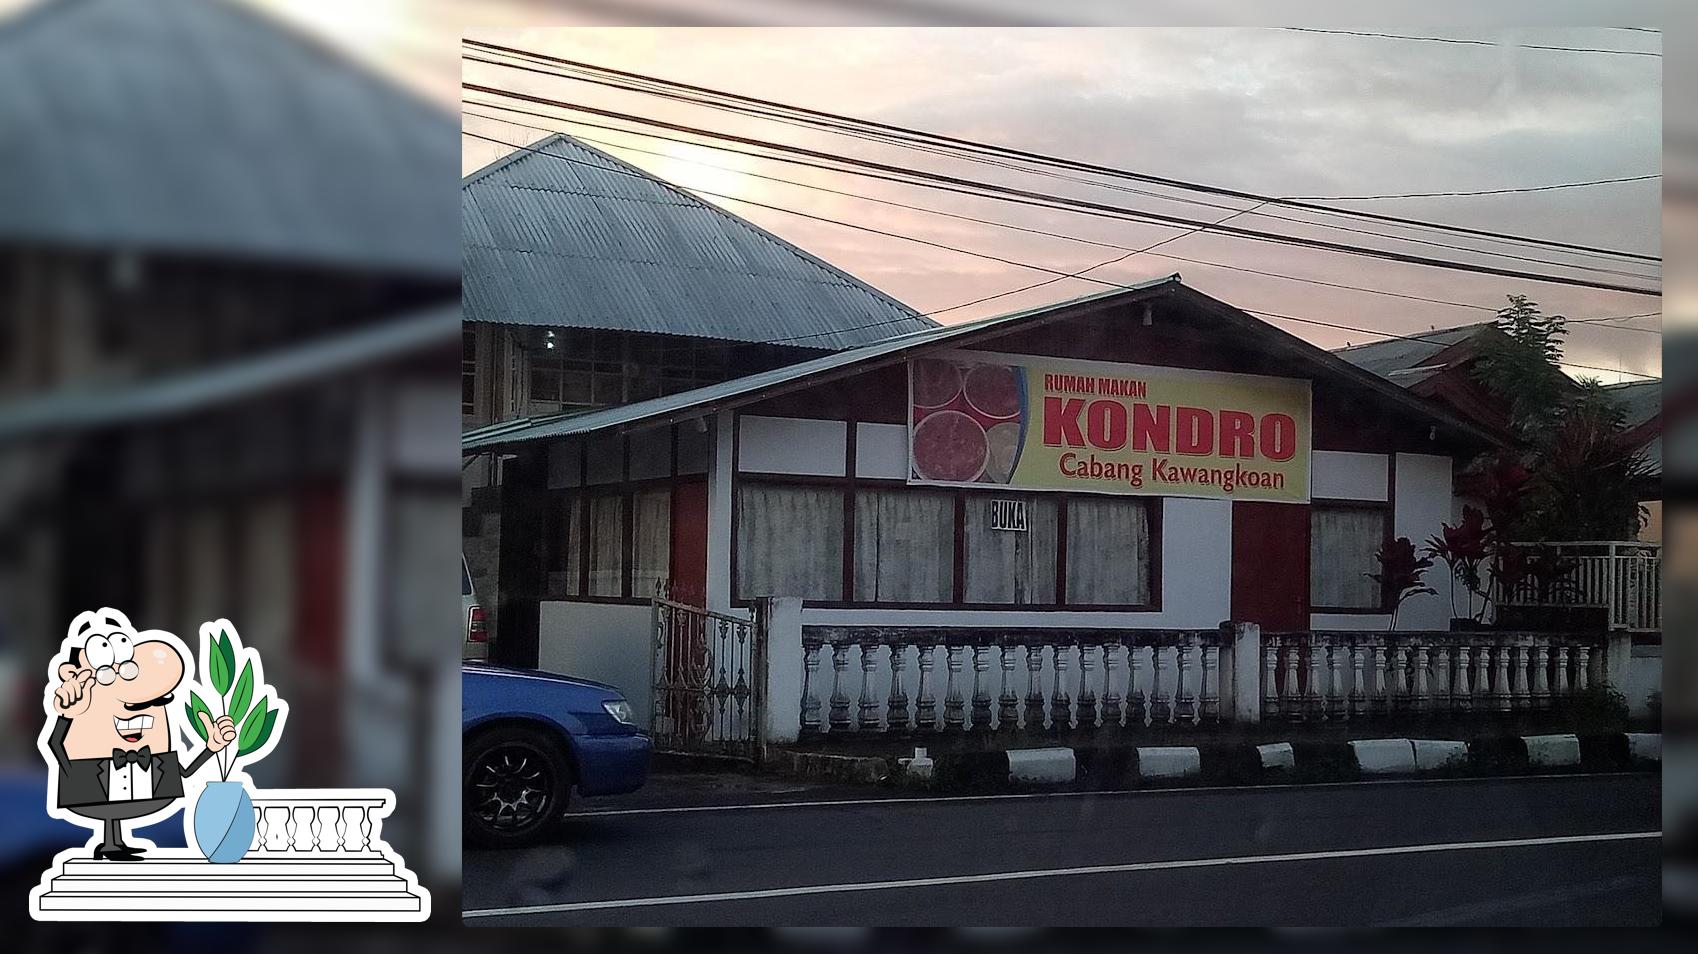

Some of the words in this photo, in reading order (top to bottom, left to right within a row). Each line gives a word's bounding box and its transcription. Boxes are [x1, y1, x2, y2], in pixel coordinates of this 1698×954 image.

[1044, 373, 1095, 394] RUMAH
[1098, 378, 1147, 399] MAKAN
[1043, 397, 1296, 462] KONDRO
[1059, 453, 1143, 488] Cabang
[1152, 458, 1285, 493] Kawangkoan
[991, 500, 1026, 530] BUKA
